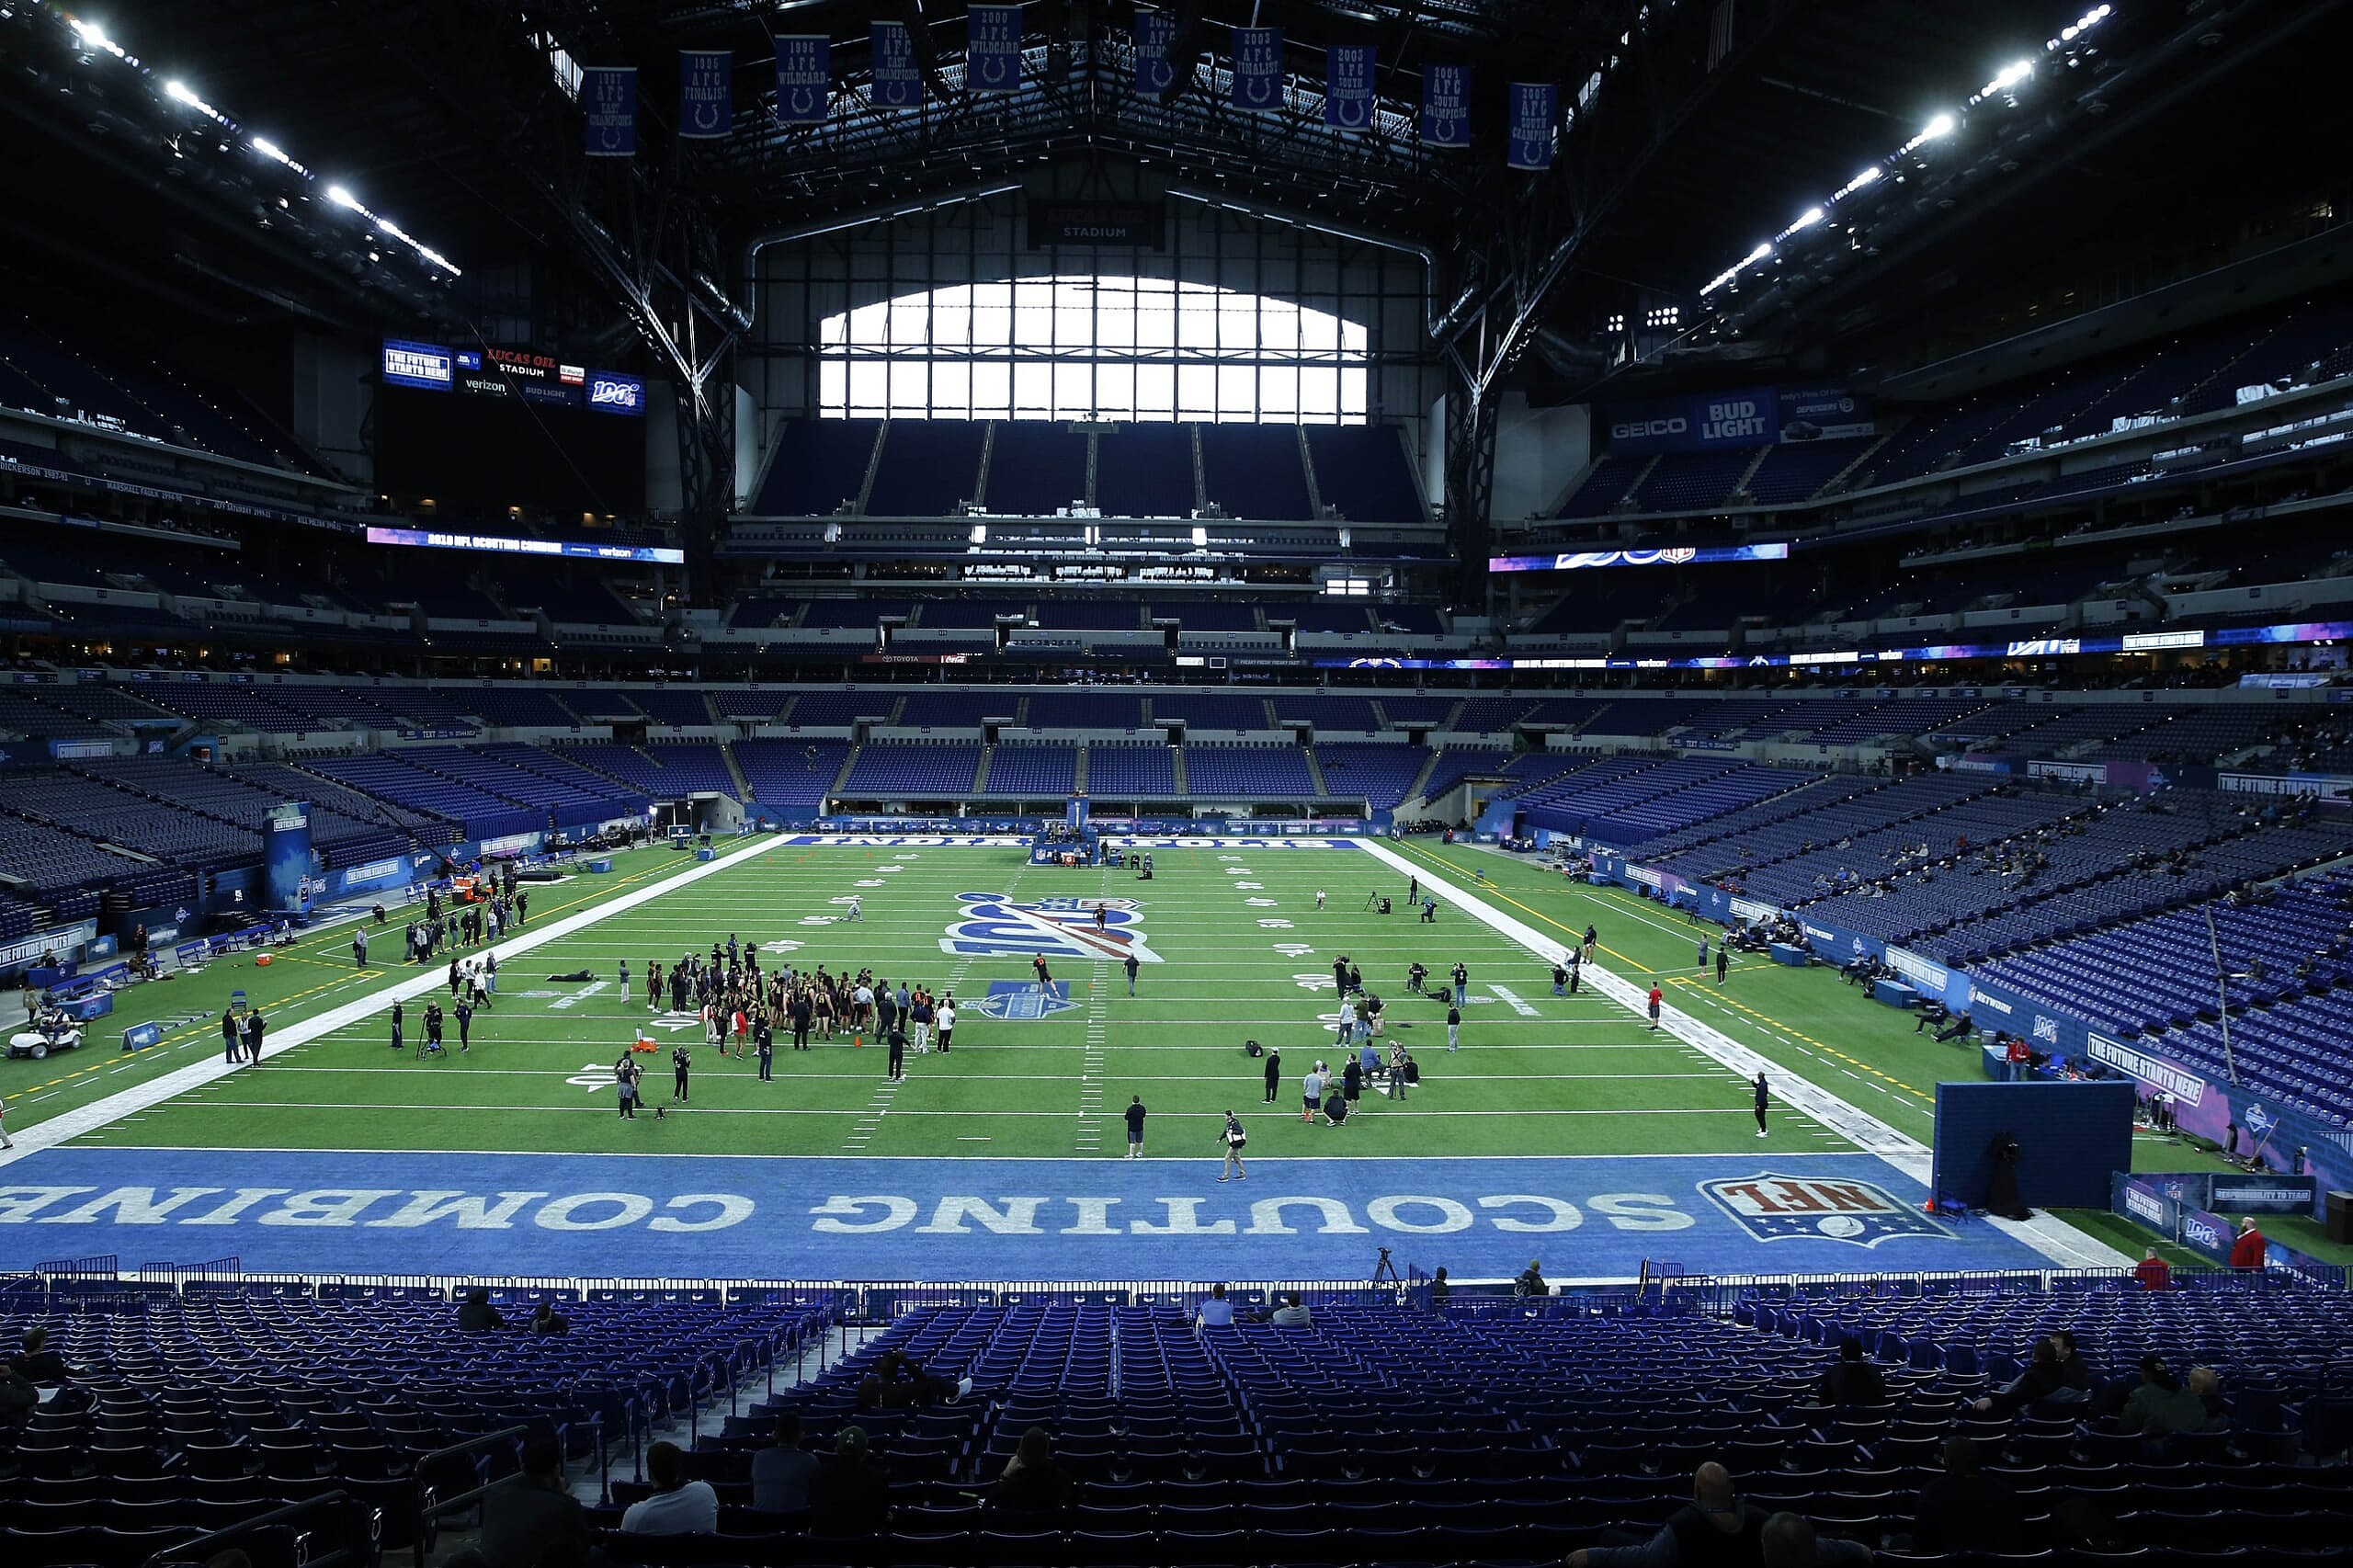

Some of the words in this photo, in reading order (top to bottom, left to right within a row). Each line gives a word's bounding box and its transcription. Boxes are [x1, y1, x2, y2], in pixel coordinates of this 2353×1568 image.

[980, 27, 1007, 40] AFC
[883, 40, 912, 55] AFC
[971, 40, 1018, 54] WILDCARD
[1243, 48, 1272, 61] AFC
[788, 57, 815, 69] AFC
[1236, 61, 1279, 74] FINALIST
[1338, 62, 1363, 75] AFC
[692, 73, 721, 85] AFC
[779, 72, 825, 85] WILDCARD
[875, 68, 919, 80] CHAMPIONS
[597, 85, 623, 102] AFC
[1434, 79, 1461, 95] AFC
[1426, 104, 1467, 119] CHAMPIONS
[1521, 100, 1548, 117] AFC
[1063, 227, 1126, 238] STADIUM
[389, 352, 406, 363] THE
[407, 354, 441, 368] FUTURE
[487, 348, 530, 365] LUCAS
[533, 356, 556, 369] OIL
[425, 367, 448, 378] HERE
[499, 364, 545, 377] STADIUM
[466, 379, 506, 392] verizon
[526, 387, 543, 395] BUD
[543, 389, 566, 399] LIGHT
[1709, 401, 1756, 421] BUD
[1611, 417, 1688, 439] GEICO
[1701, 416, 1766, 439] LIGHT
[0, 461, 41, 477] DICKERSON
[107, 482, 141, 495] MARSHALL
[454, 535, 472, 547] NFL
[472, 537, 519, 550] SCOUTING
[598, 547, 631, 557] verizon
[1637, 658, 1667, 667] verizon
[2221, 777, 2239, 791] THE
[2240, 778, 2277, 794] FUTURE
[11, 941, 39, 960] FUTURE
[39, 936, 68, 954] STARTS
[1975, 990, 2013, 1015] NETWORK
[2090, 1037, 2106, 1058] THE
[2107, 1043, 2140, 1072] FUTURE
[2139, 1058, 2175, 1090] STARTS
[2175, 1074, 2201, 1101] HERE
[1730, 1180, 1888, 1213] NFL
[2130, 1189, 2140, 1202] THE
[2140, 1193, 2160, 1210] FUTURE
[2278, 1190, 2287, 1199] TO
[2288, 1190, 2309, 1200] TEAM
[0, 1185, 753, 1233] COMBINE
[809, 1192, 1697, 1235] SCOUTING
